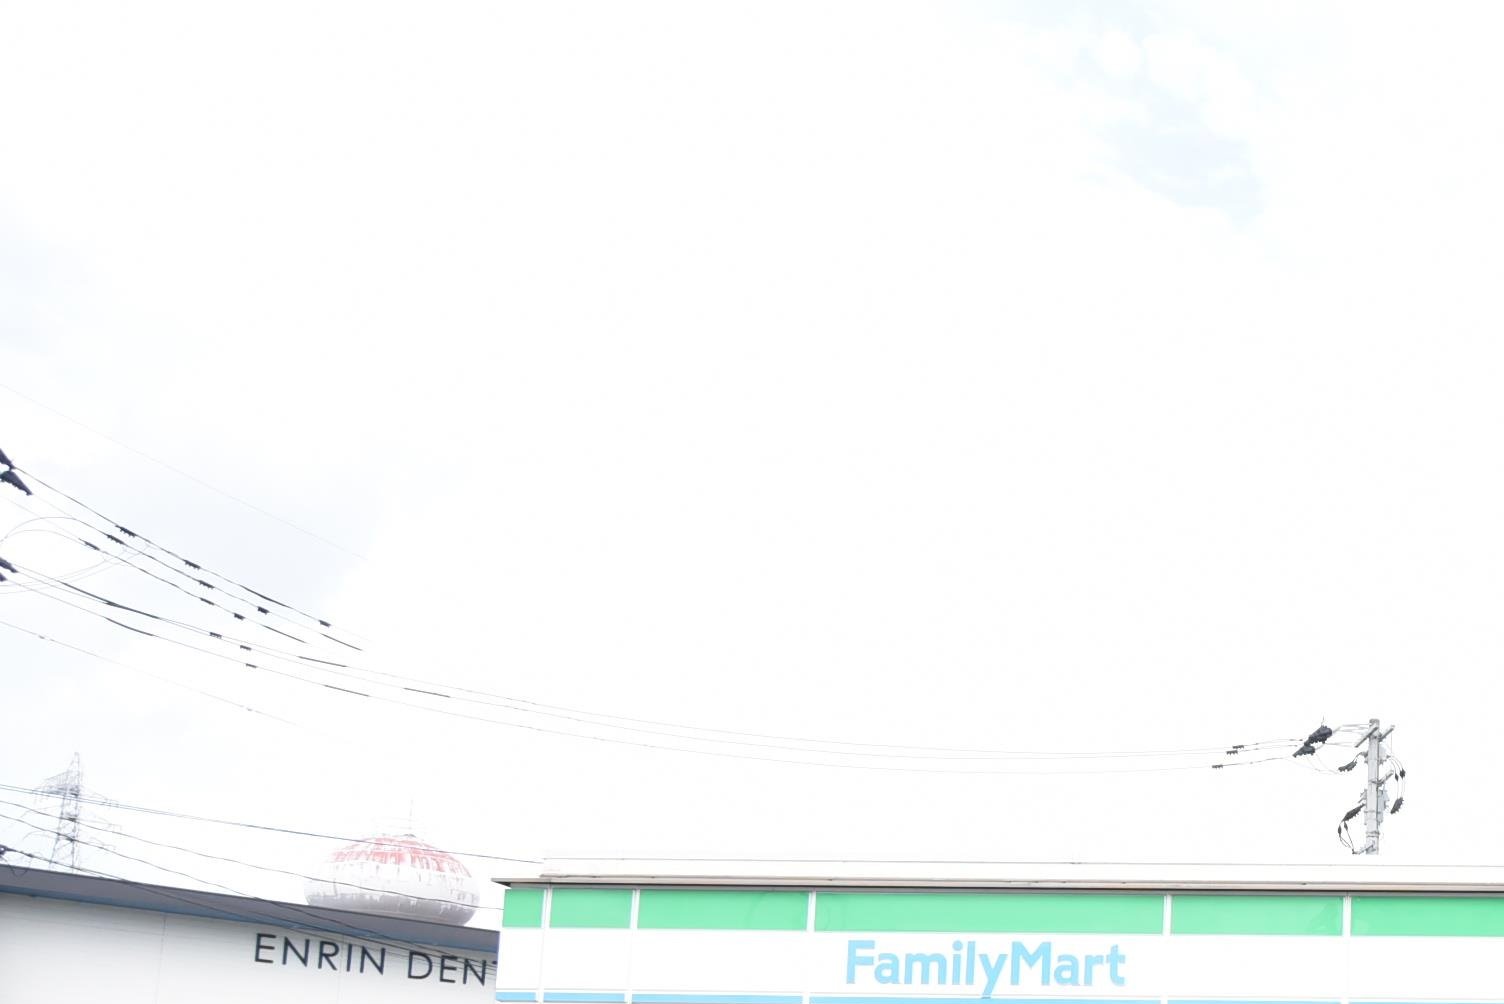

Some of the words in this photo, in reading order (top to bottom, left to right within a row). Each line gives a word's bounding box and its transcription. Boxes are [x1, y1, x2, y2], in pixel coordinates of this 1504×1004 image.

[254, 932, 387, 976] ENRIN
[407, 950, 497, 987] DEN
[845, 939, 1126, 1000] FamilyMart
